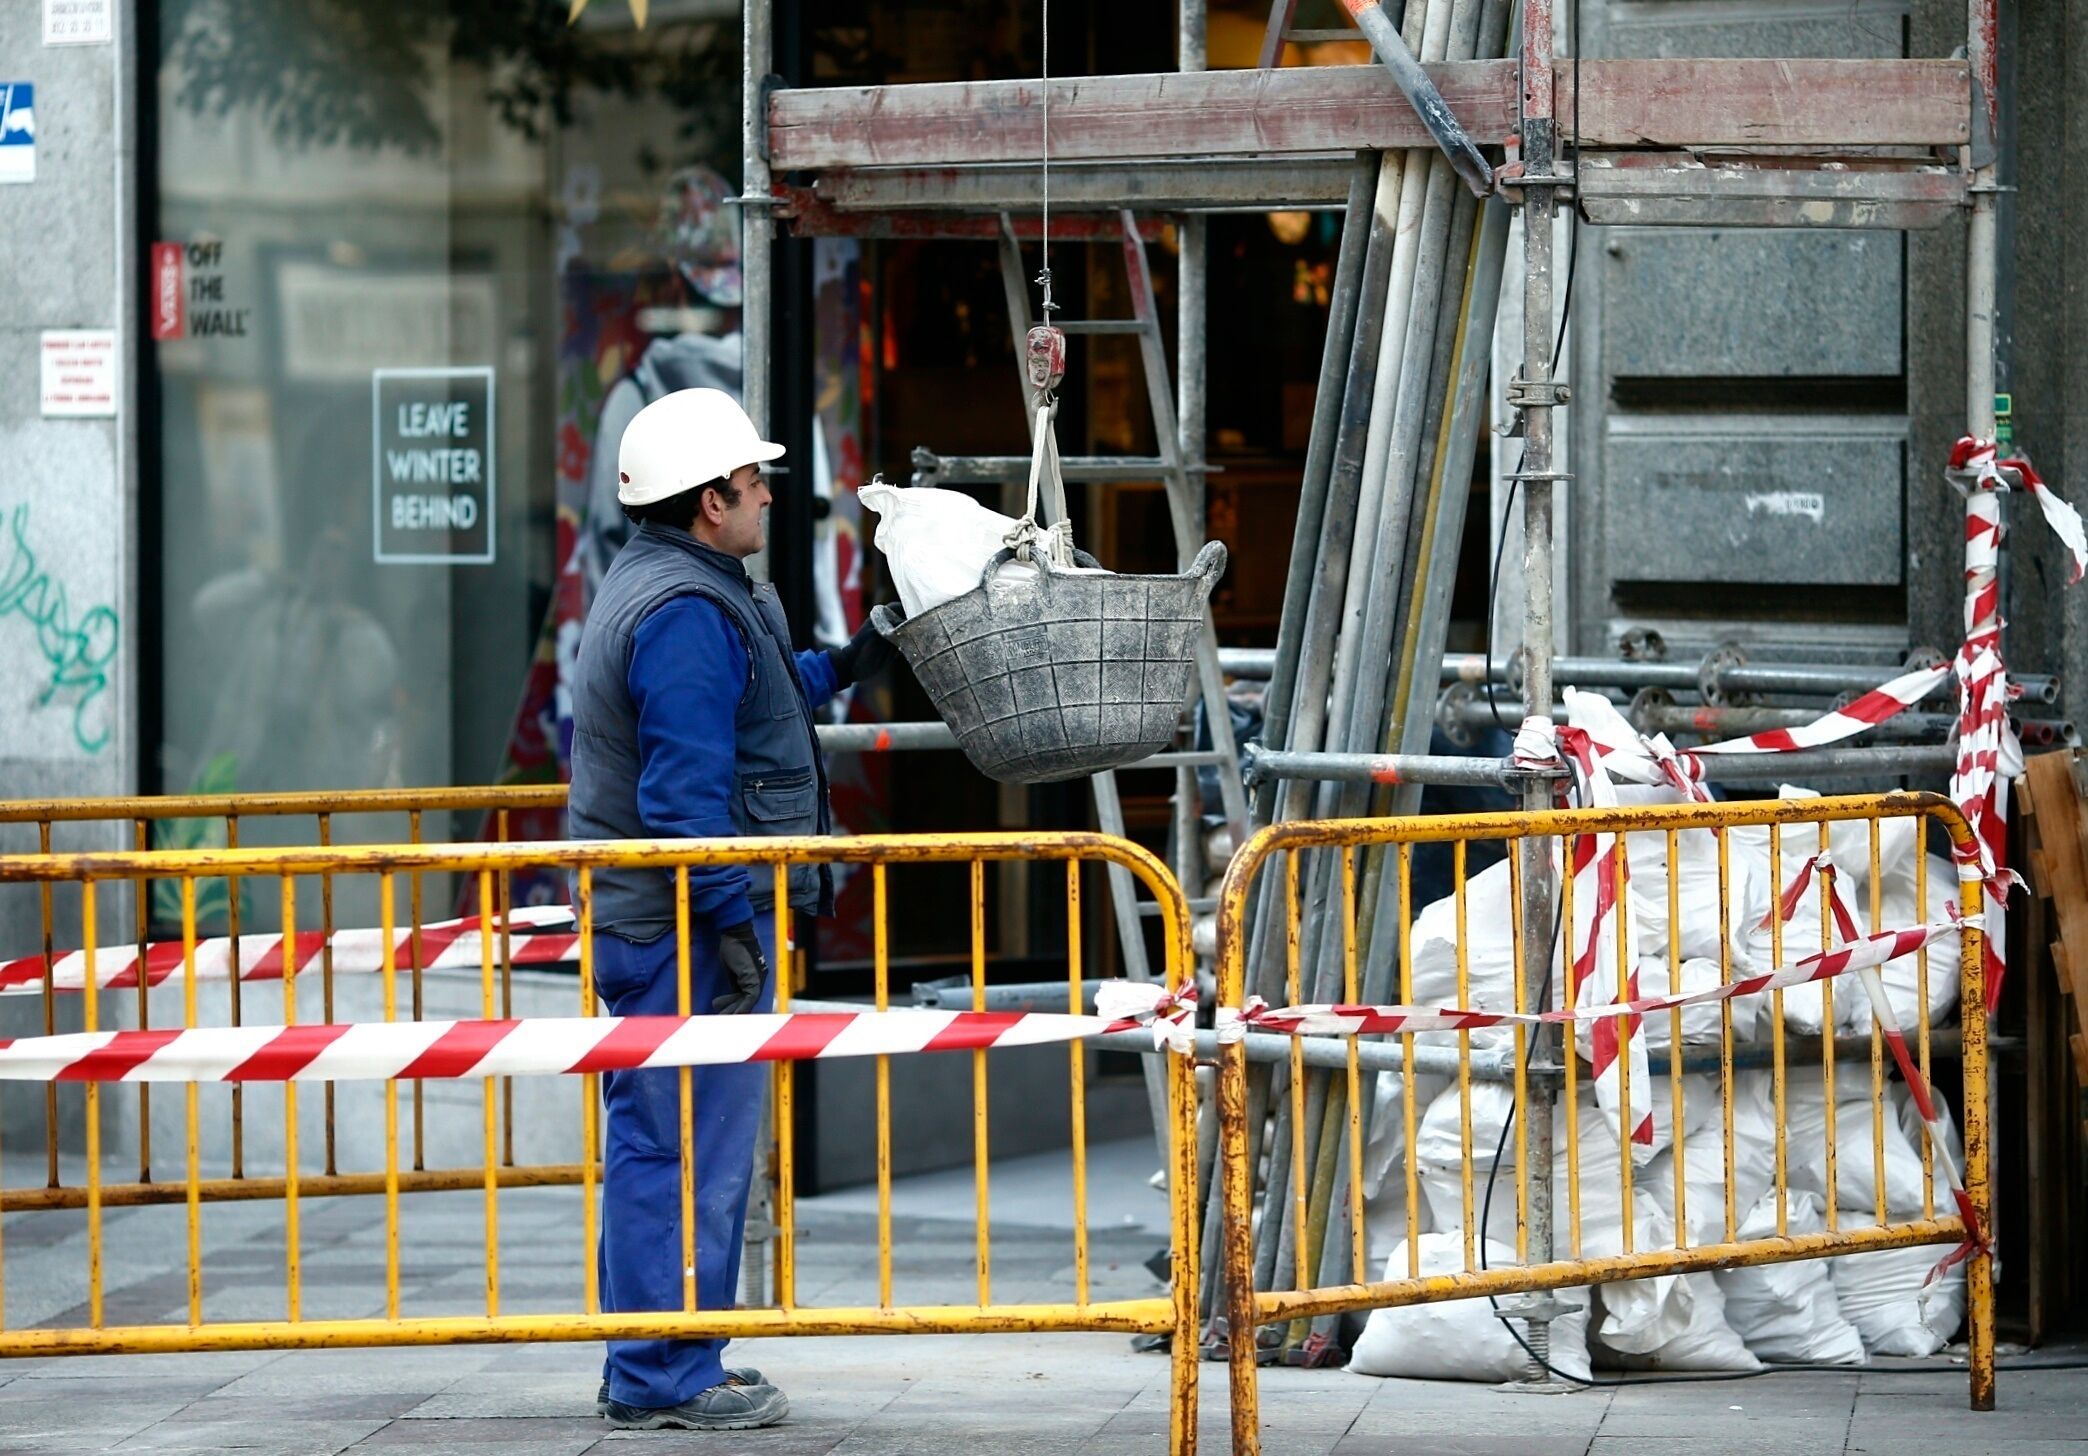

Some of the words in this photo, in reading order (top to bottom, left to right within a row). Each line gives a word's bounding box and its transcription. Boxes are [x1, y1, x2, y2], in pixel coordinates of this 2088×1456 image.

[190, 276, 223, 302] THE
[398, 402, 469, 437] LEAVE
[386, 449, 481, 484] WINTER
[392, 494, 477, 529] BEHIND
